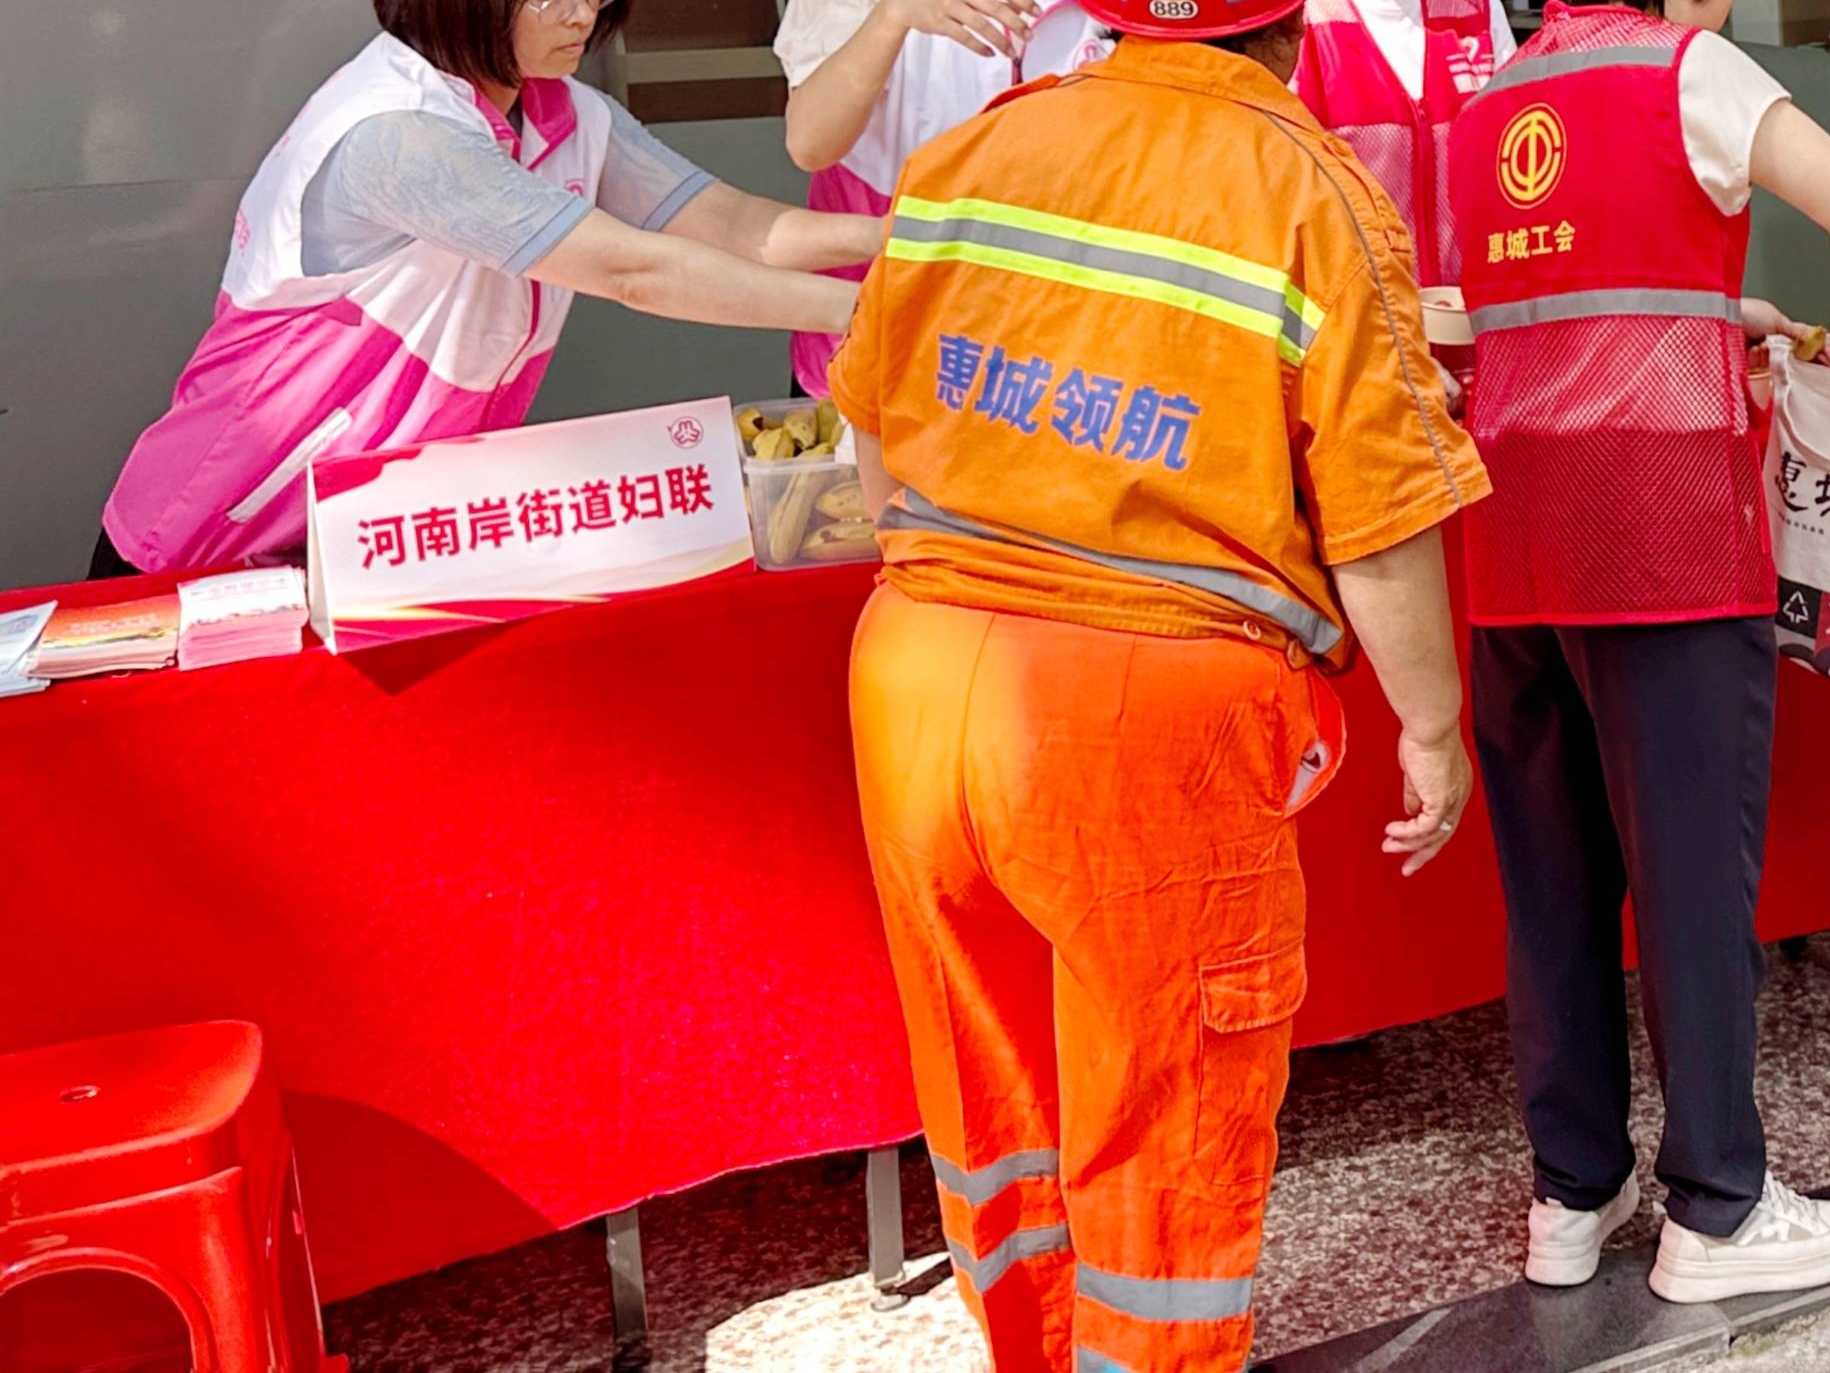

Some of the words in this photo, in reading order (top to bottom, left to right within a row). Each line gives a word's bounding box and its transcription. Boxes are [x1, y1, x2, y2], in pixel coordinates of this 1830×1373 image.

[1486, 220, 1577, 265] 惠城工会
[934, 332, 1202, 472] 惠城领航
[356, 462, 717, 571] 河南岸街道妇联
